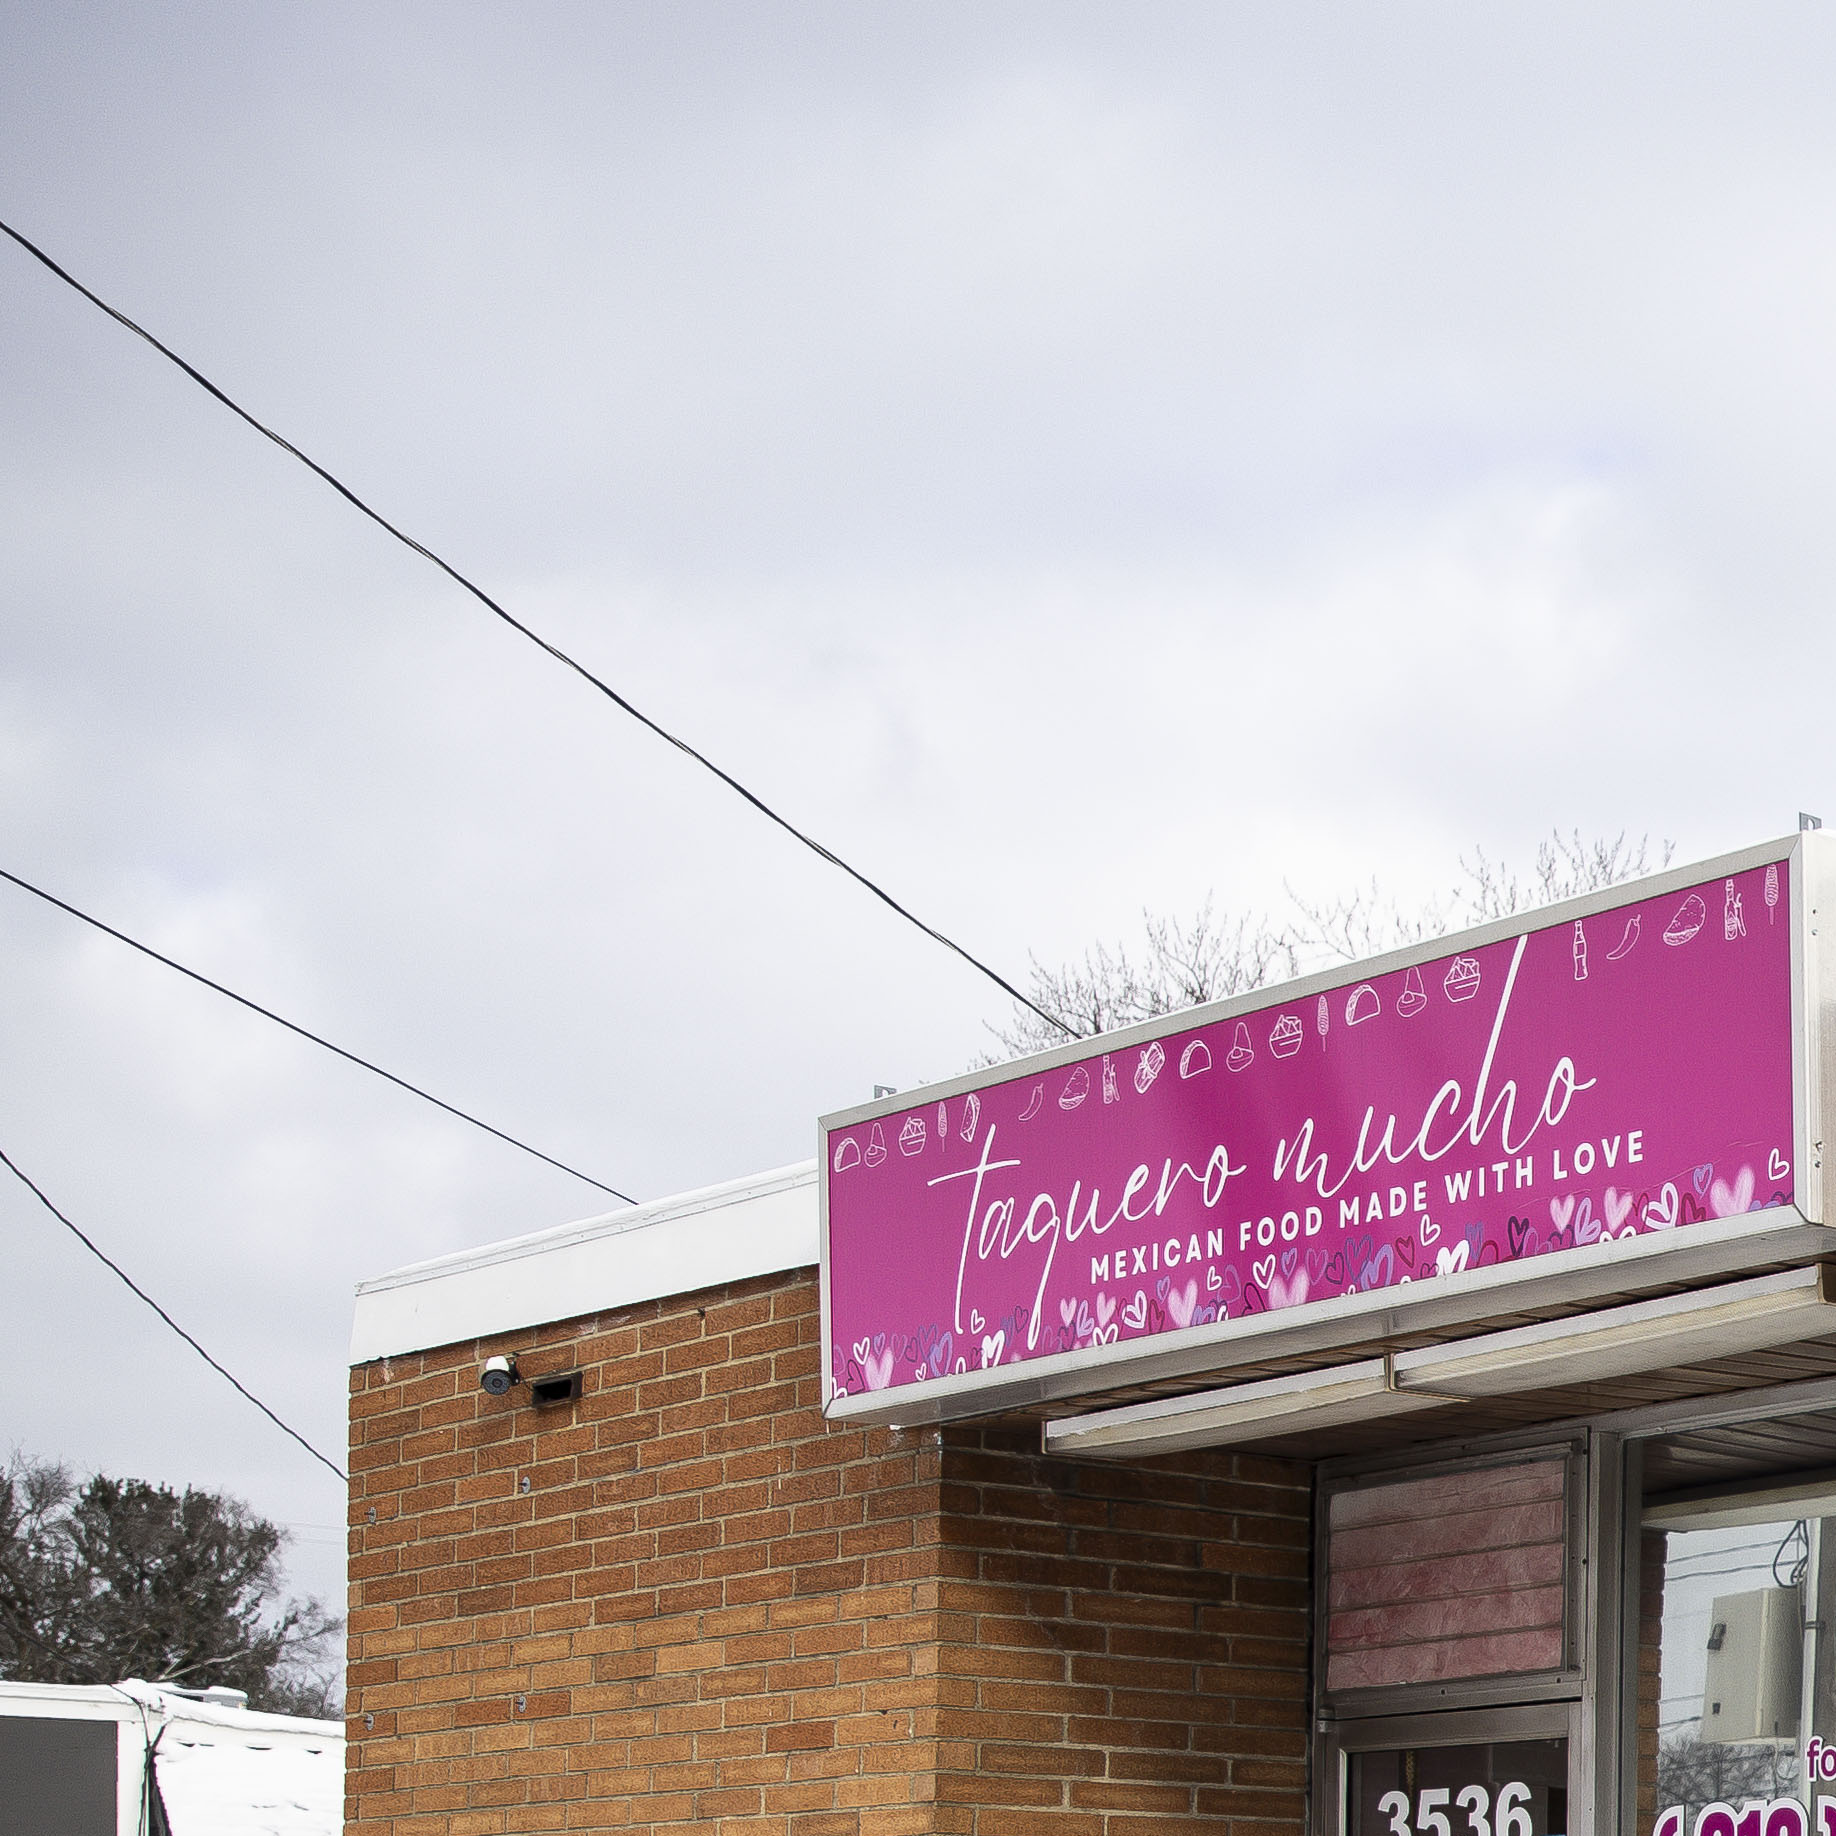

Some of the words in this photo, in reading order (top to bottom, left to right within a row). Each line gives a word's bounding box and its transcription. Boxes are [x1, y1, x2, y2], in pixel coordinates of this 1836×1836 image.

[1273, 933, 1597, 1198] mucho
[1090, 1228, 1224, 1285] MEXICAN
[1239, 1204, 1325, 1251] FOOD
[1339, 1186, 1428, 1230] MADE
[1444, 1154, 1534, 1206] WITH
[1553, 1129, 1647, 1177] LOVE
